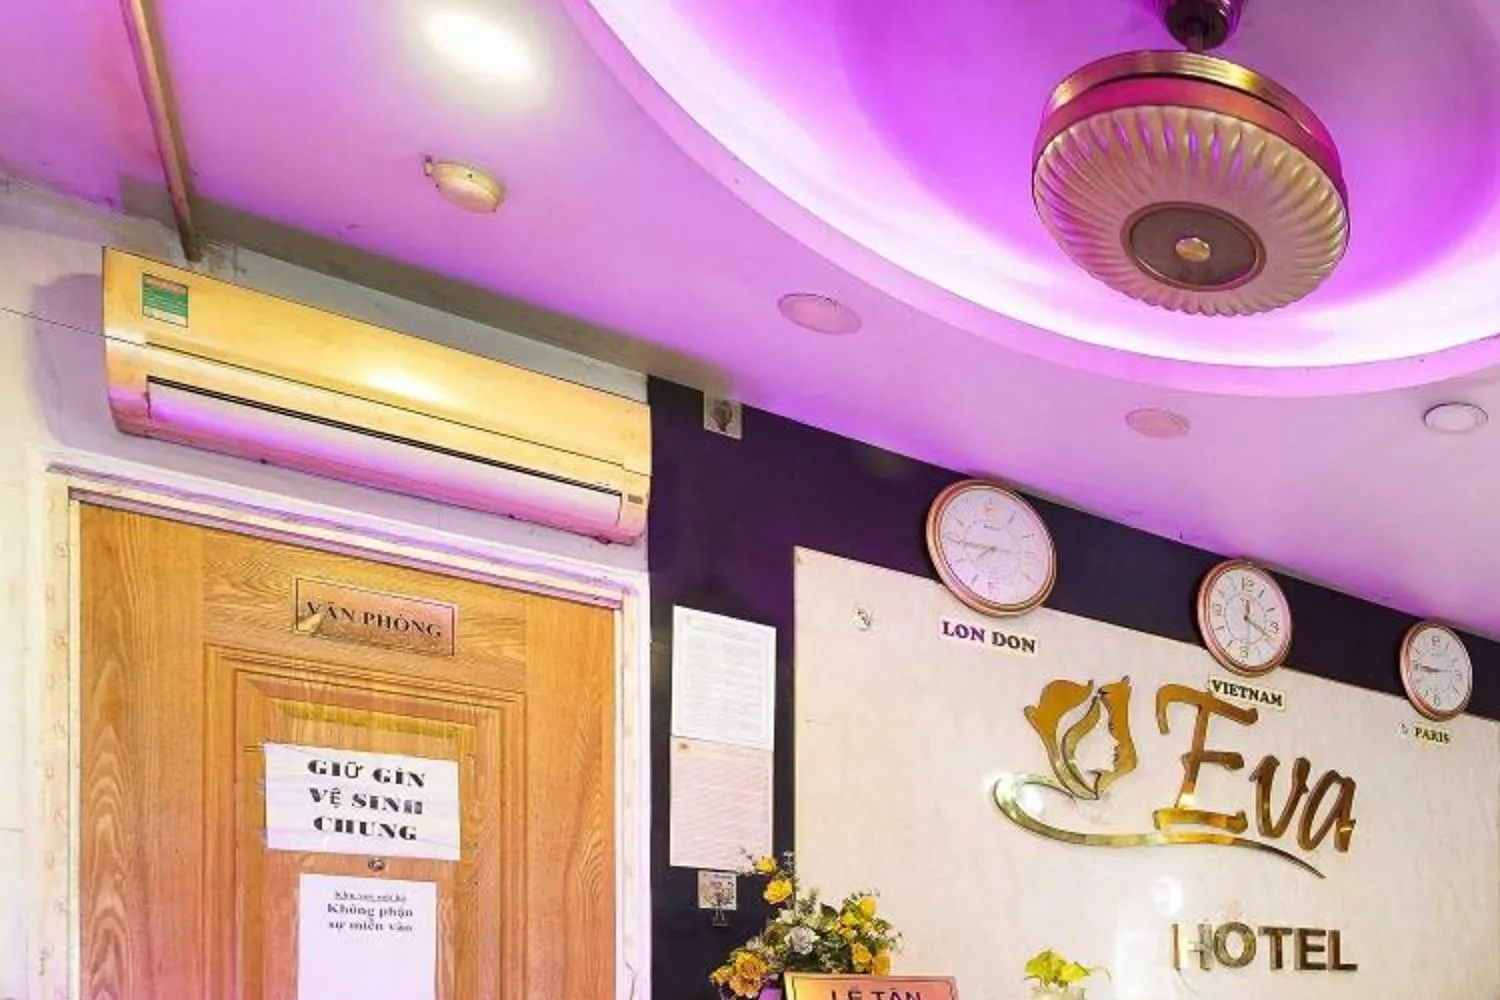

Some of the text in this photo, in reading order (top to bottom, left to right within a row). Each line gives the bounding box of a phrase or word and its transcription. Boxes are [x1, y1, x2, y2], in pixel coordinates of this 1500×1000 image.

[941, 620, 1037, 653] LON DON
[1212, 679, 1283, 707] VIETNAM
[1414, 727, 1451, 744] PARIS
[307, 758, 426, 788] GIỮ GÌN
[1152, 682, 1357, 852] Eva
[309, 787, 424, 815] VỆ SINH
[313, 815, 417, 841] CHUNG
[1170, 920, 1360, 974] HOTEL
